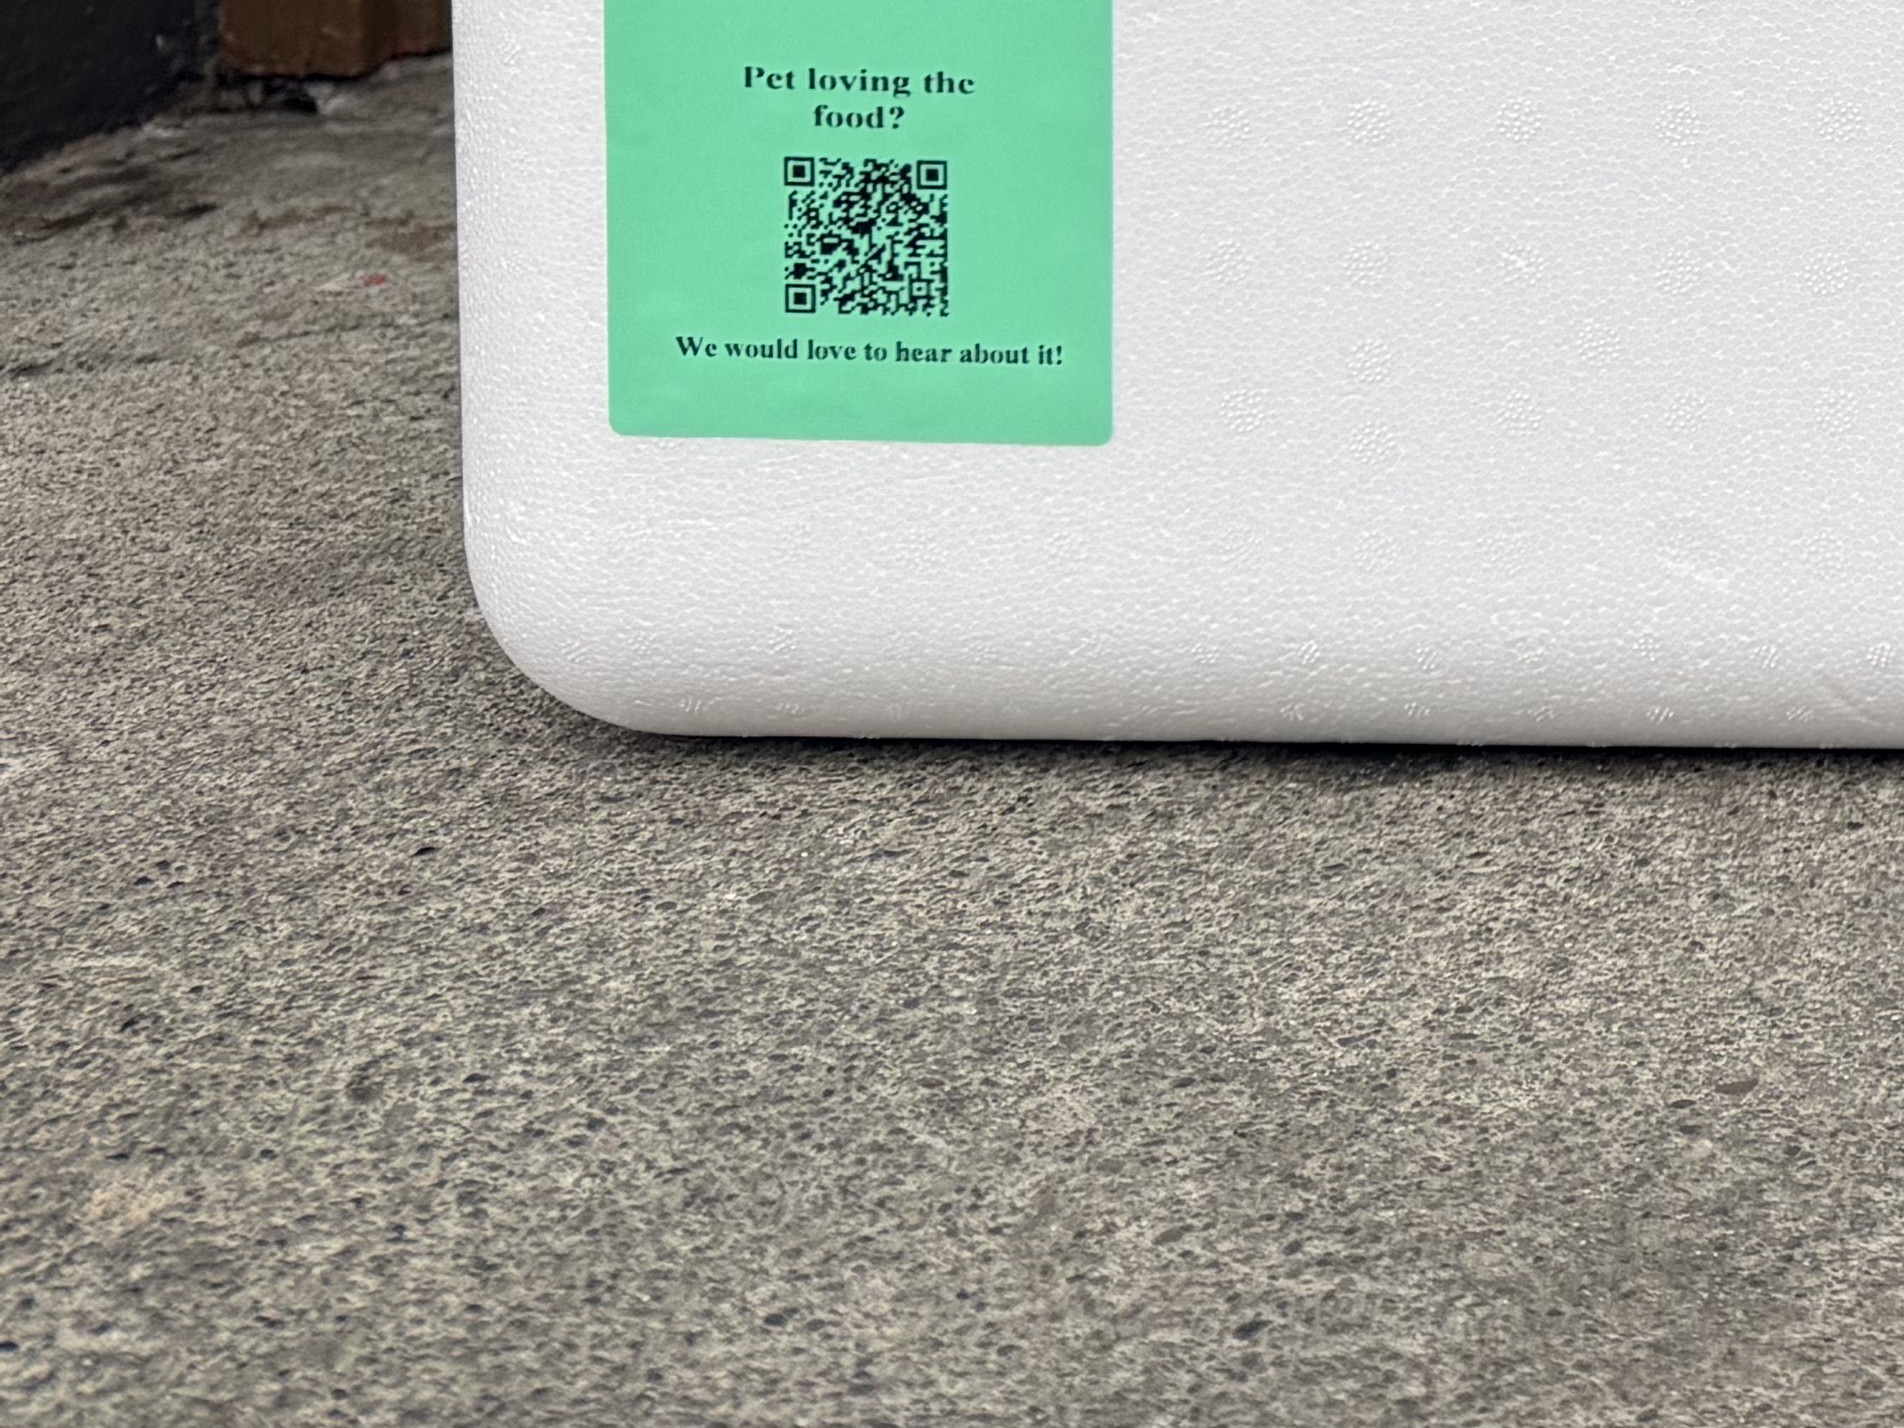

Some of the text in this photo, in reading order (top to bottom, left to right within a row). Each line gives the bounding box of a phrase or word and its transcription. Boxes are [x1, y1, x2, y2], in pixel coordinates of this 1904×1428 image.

[744, 66, 975, 98] Pet loving the
[814, 104, 905, 130] food?
[675, 336, 1063, 366] We would love to hear about it!
